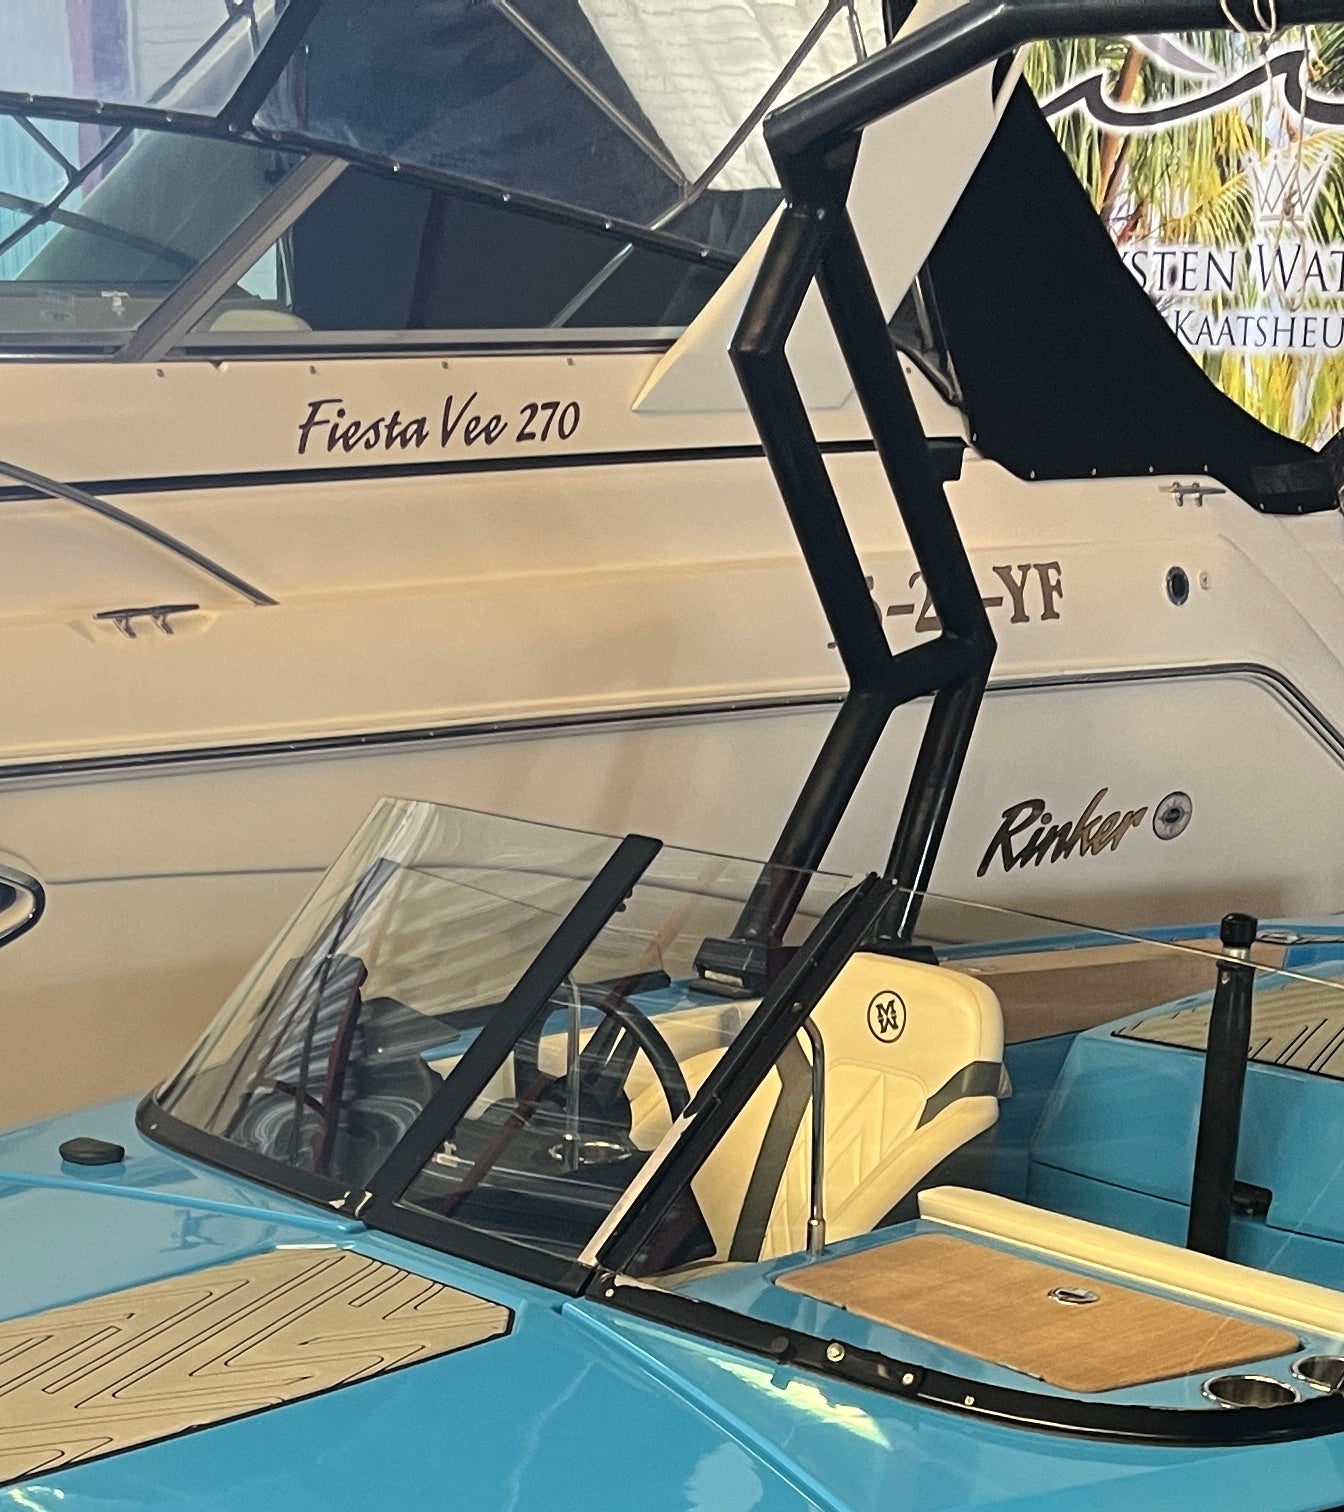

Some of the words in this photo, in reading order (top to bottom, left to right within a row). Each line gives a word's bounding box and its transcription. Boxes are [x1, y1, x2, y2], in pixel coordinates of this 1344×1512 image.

[297, 397, 430, 455] Fiesta
[440, 391, 508, 449] Vee
[515, 400, 581, 443] 270
[976, 787, 1149, 878] Rinker
